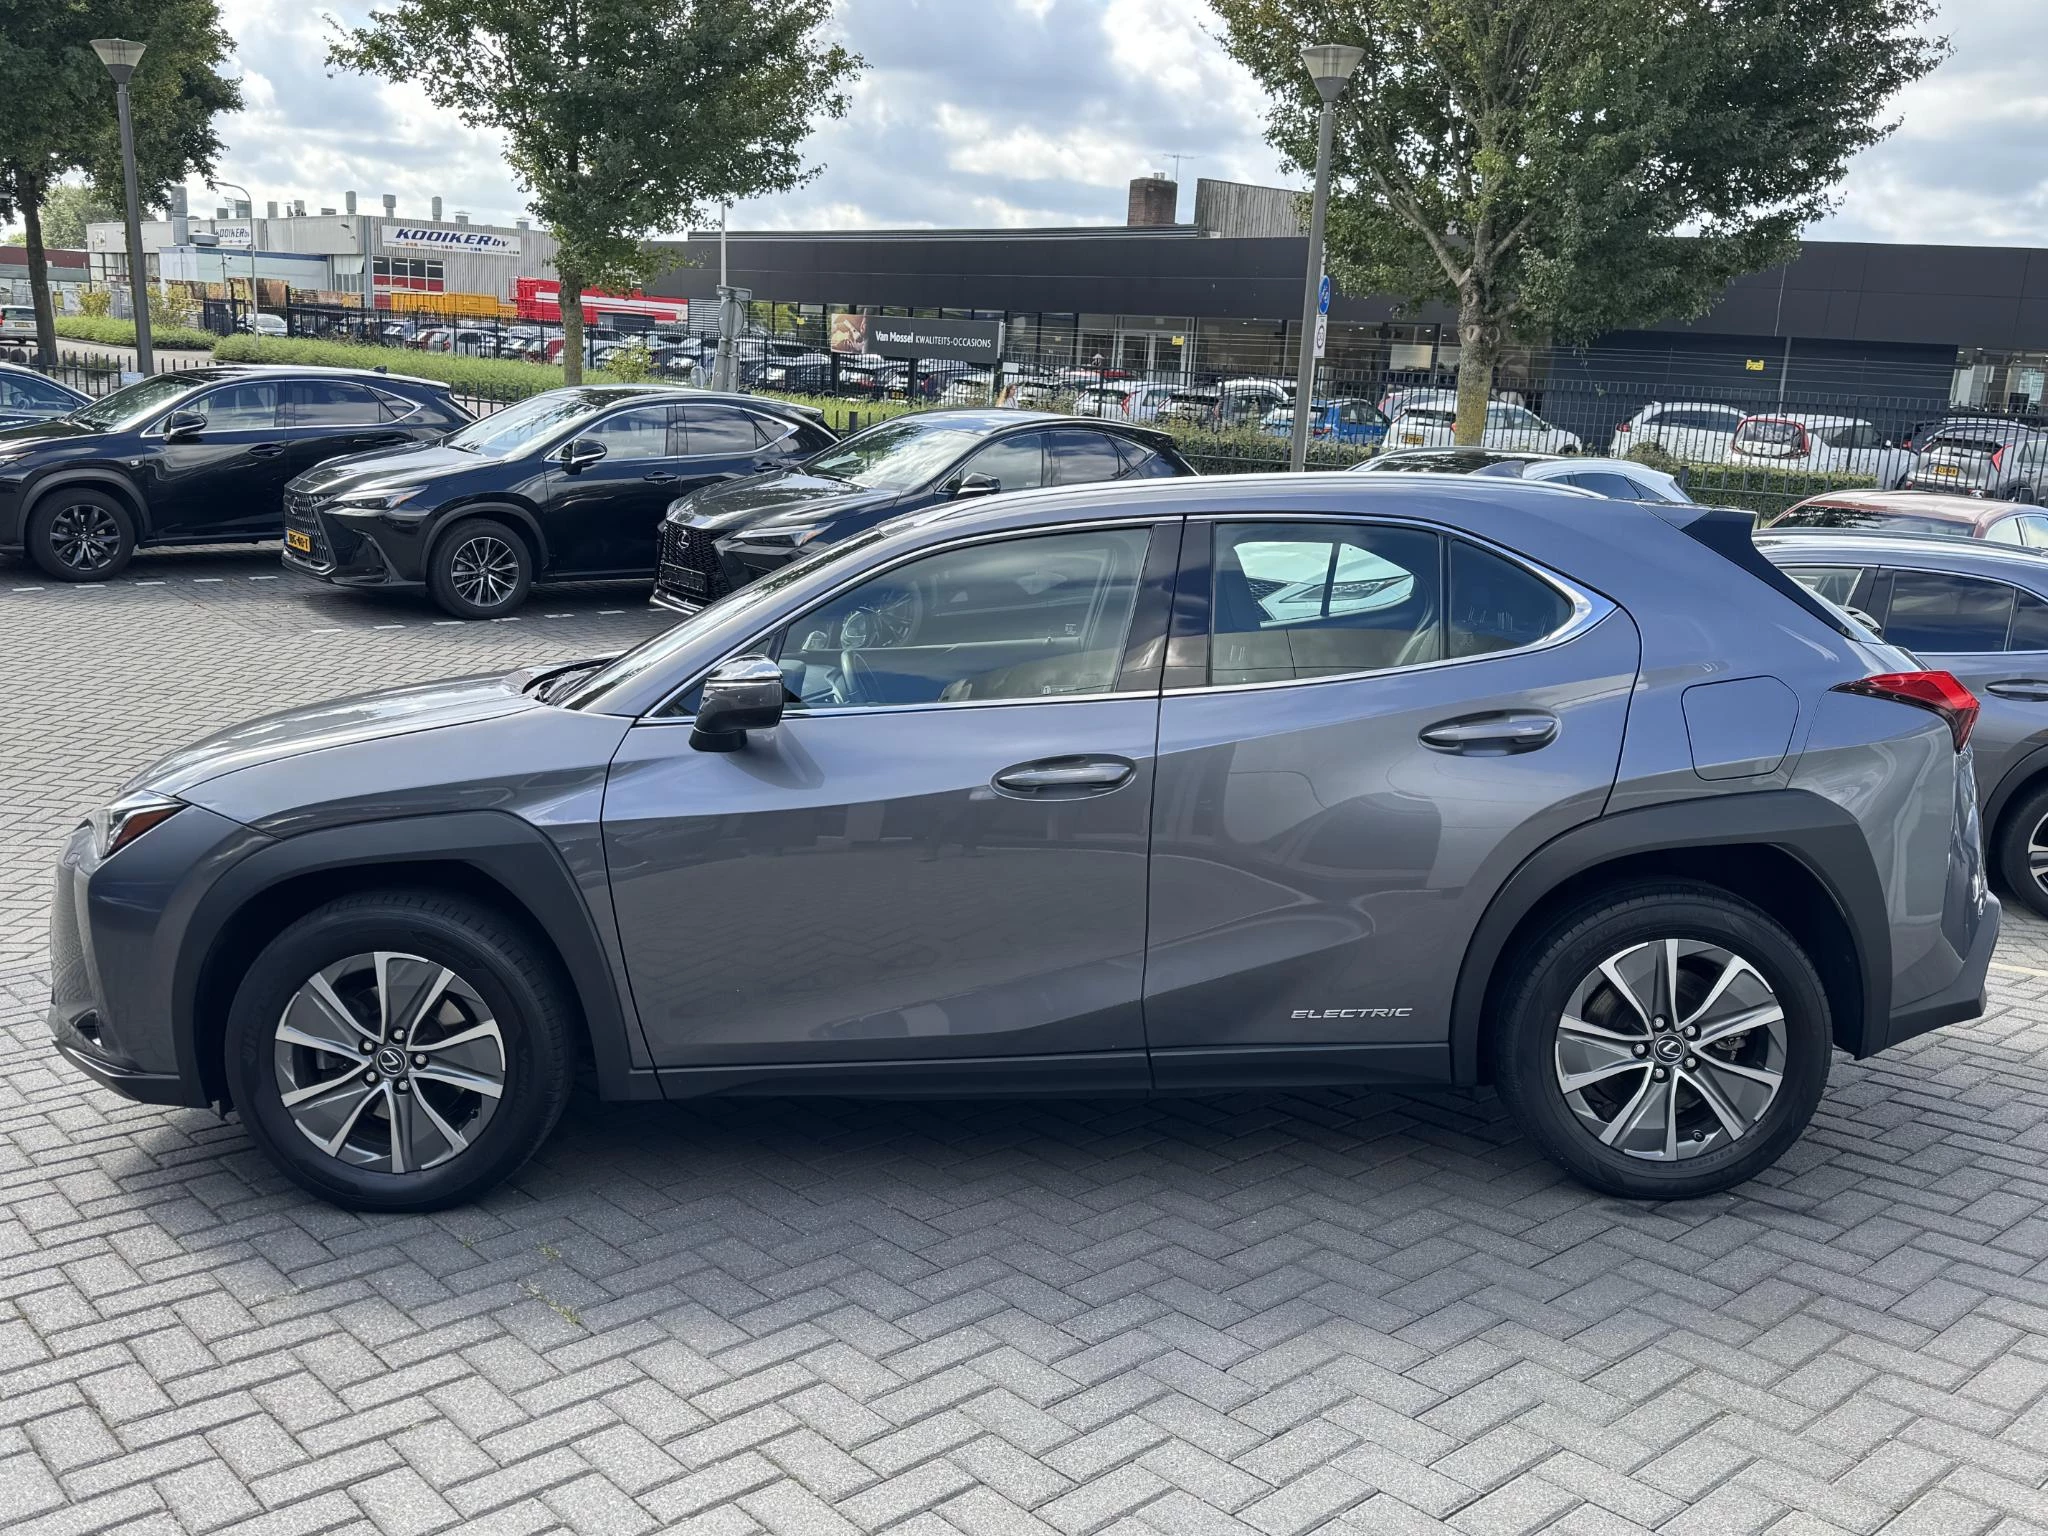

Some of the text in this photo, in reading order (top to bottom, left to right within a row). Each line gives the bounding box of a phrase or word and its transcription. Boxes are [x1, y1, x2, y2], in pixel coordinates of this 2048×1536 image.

[395, 228, 493, 246] KOOIKER
[491, 237, 509, 248] bv
[875, 330, 992, 349] Van Mossel KWALITEITS-OCCASIONS
[1290, 1007, 1414, 1019] ELECTRIC
